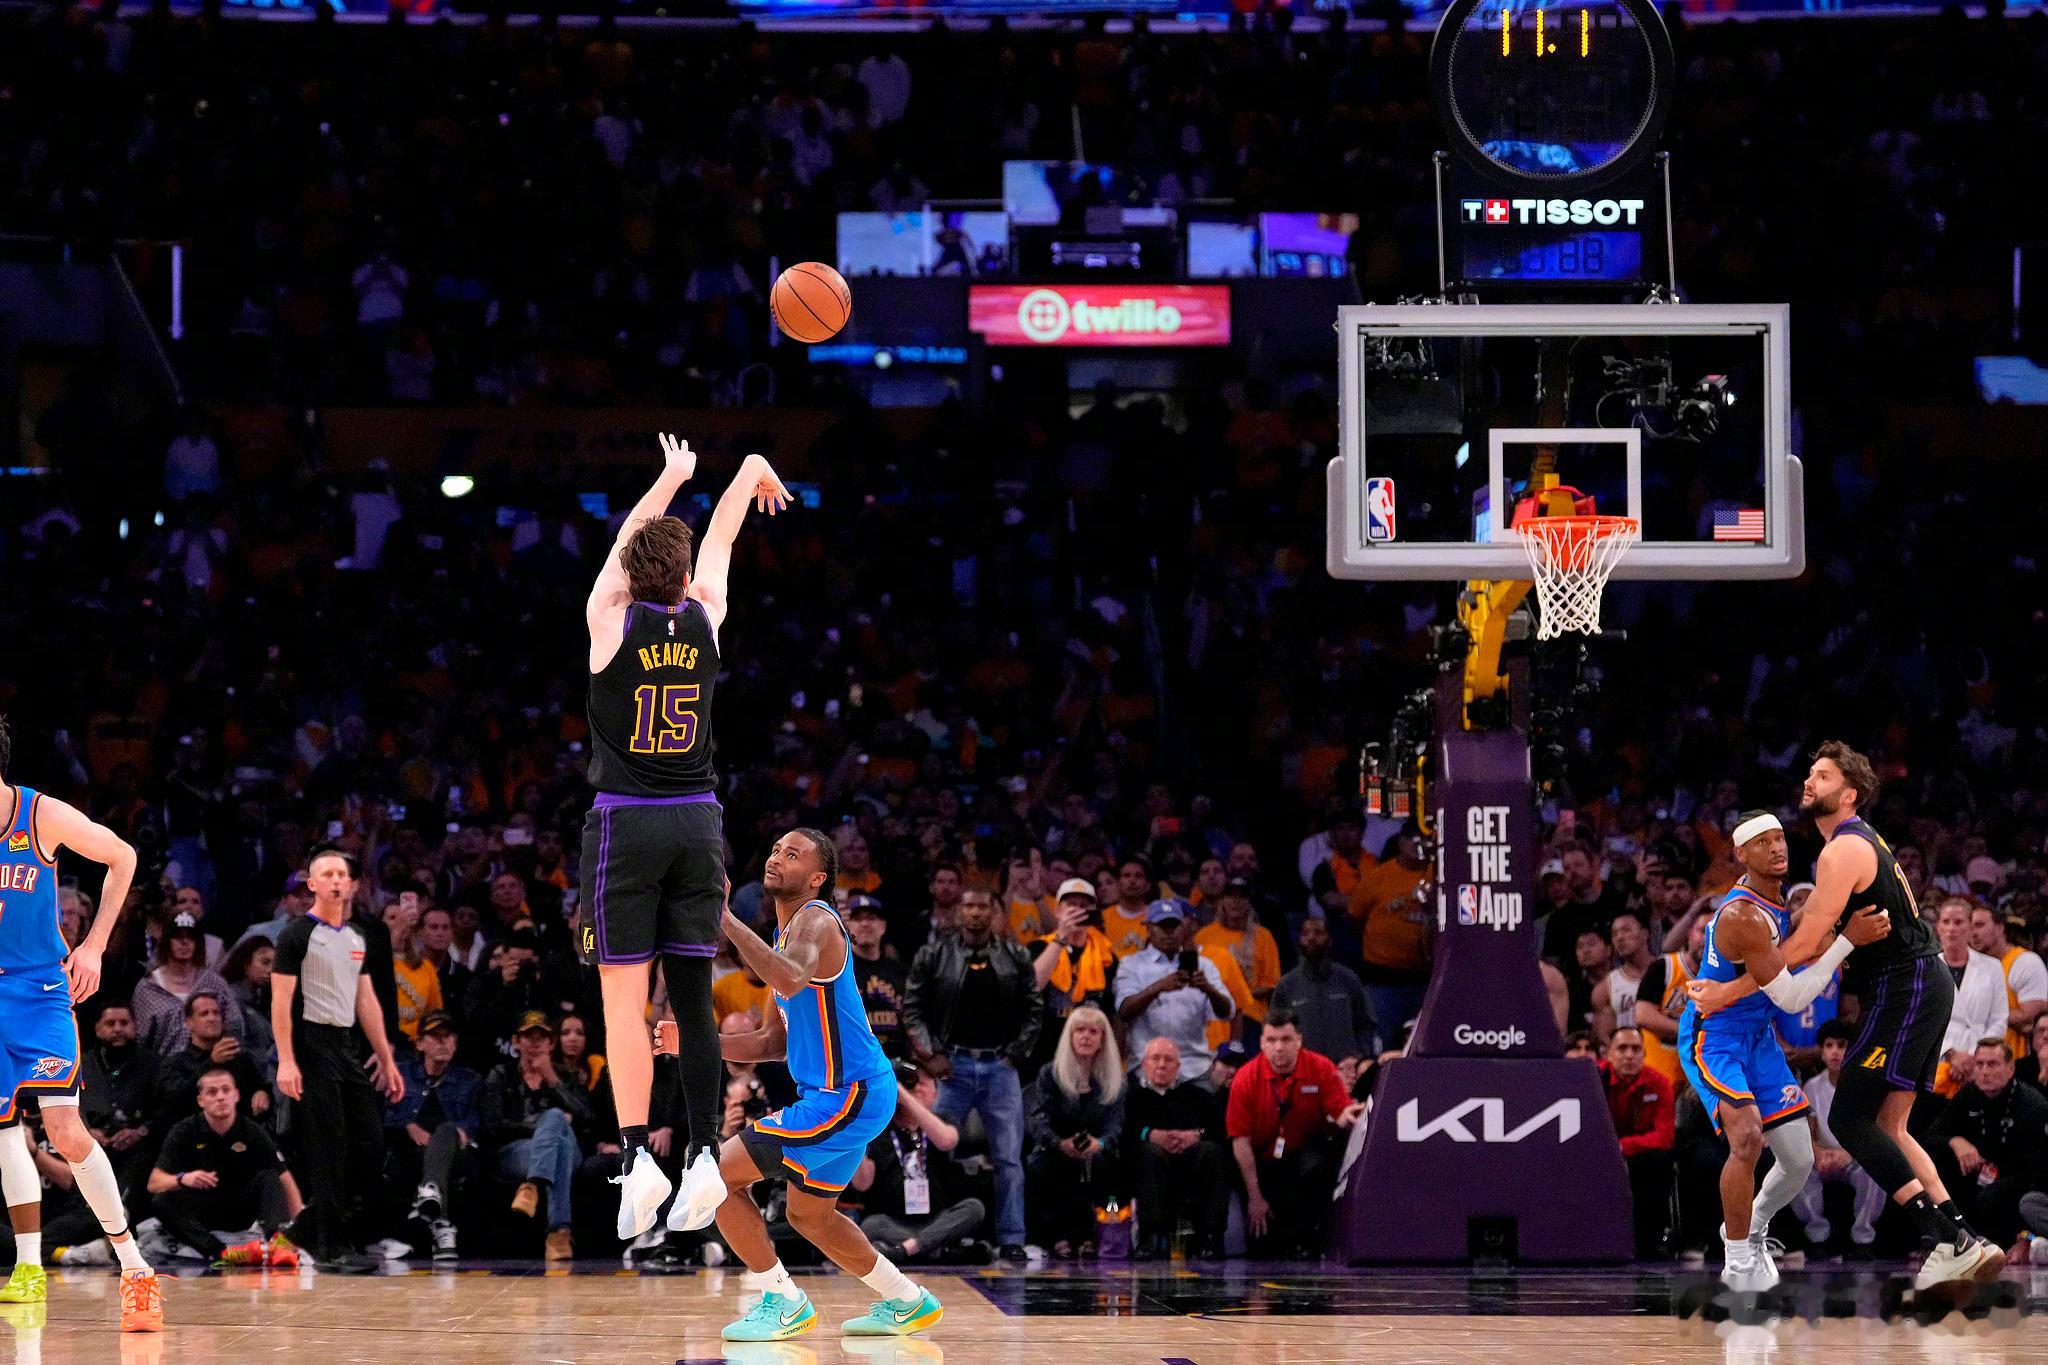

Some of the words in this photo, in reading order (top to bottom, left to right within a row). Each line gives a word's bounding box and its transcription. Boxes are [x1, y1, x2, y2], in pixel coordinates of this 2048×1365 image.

[1502, 9, 1589, 57] 11.1
[1512, 199, 1645, 225] TISSOT
[1072, 299, 1182, 334] twilio
[638, 642, 699, 672] REAVES
[629, 683, 700, 754] 15
[1467, 806, 1511, 844] GET
[1467, 844, 1512, 883] THE
[1478, 884, 1523, 932] App
[1454, 1023, 1527, 1051] Google
[1860, 1046, 1887, 1070] LA
[1396, 1096, 1582, 1144] KIA
